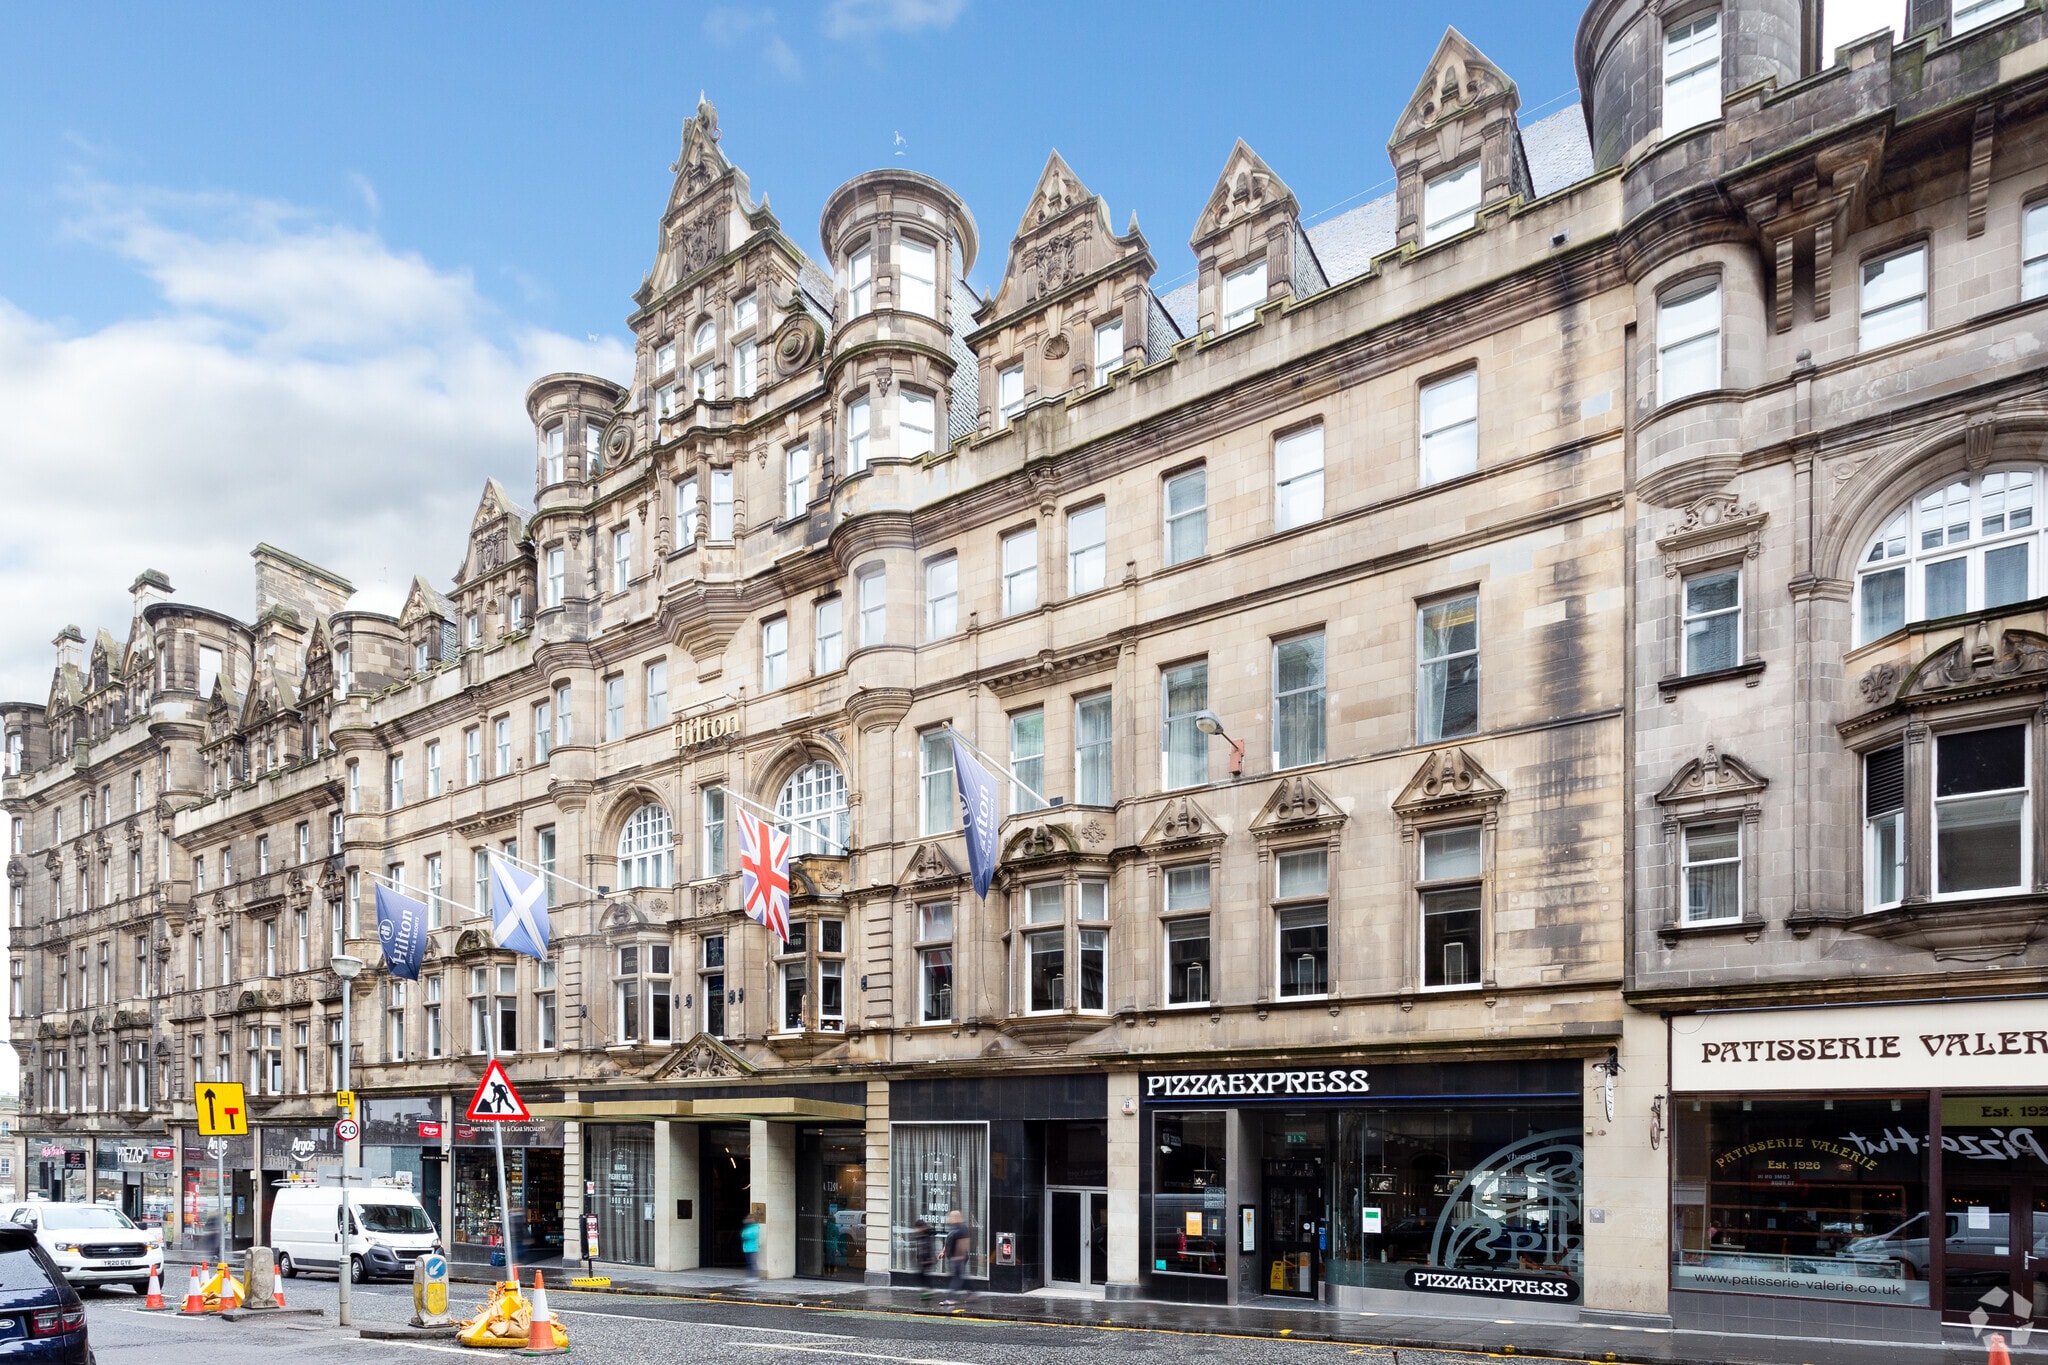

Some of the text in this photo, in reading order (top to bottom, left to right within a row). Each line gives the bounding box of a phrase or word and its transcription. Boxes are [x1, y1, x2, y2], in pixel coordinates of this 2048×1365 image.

[671, 714, 740, 751] Hilton
[393, 909, 413, 964] Hilton
[1701, 1030, 2048, 1063] PATISSERIE VALER
[1147, 1069, 1370, 1097] PIZZAEXPRESS
[1981, 1106, 2013, 1117] Est.
[341, 1125, 356, 1135] 20
[423, 1126, 438, 1134] Argos
[207, 1137, 228, 1154] Ars
[291, 1137, 315, 1155] Argos
[1715, 1138, 1878, 1171] PATISSERIE VALERIE
[117, 1146, 143, 1164] PREZZO
[1768, 1161, 1821, 1170] Est. 1926
[921, 1172, 957, 1182] 1900 BAR
[929, 1203, 948, 1212] MARCO
[919, 1214, 939, 1224] PIERRE
[1414, 1272, 1569, 1297] PIZZAEXPRESS
[1695, 1273, 1901, 1295] www.patisserie-valerie.co.uk
